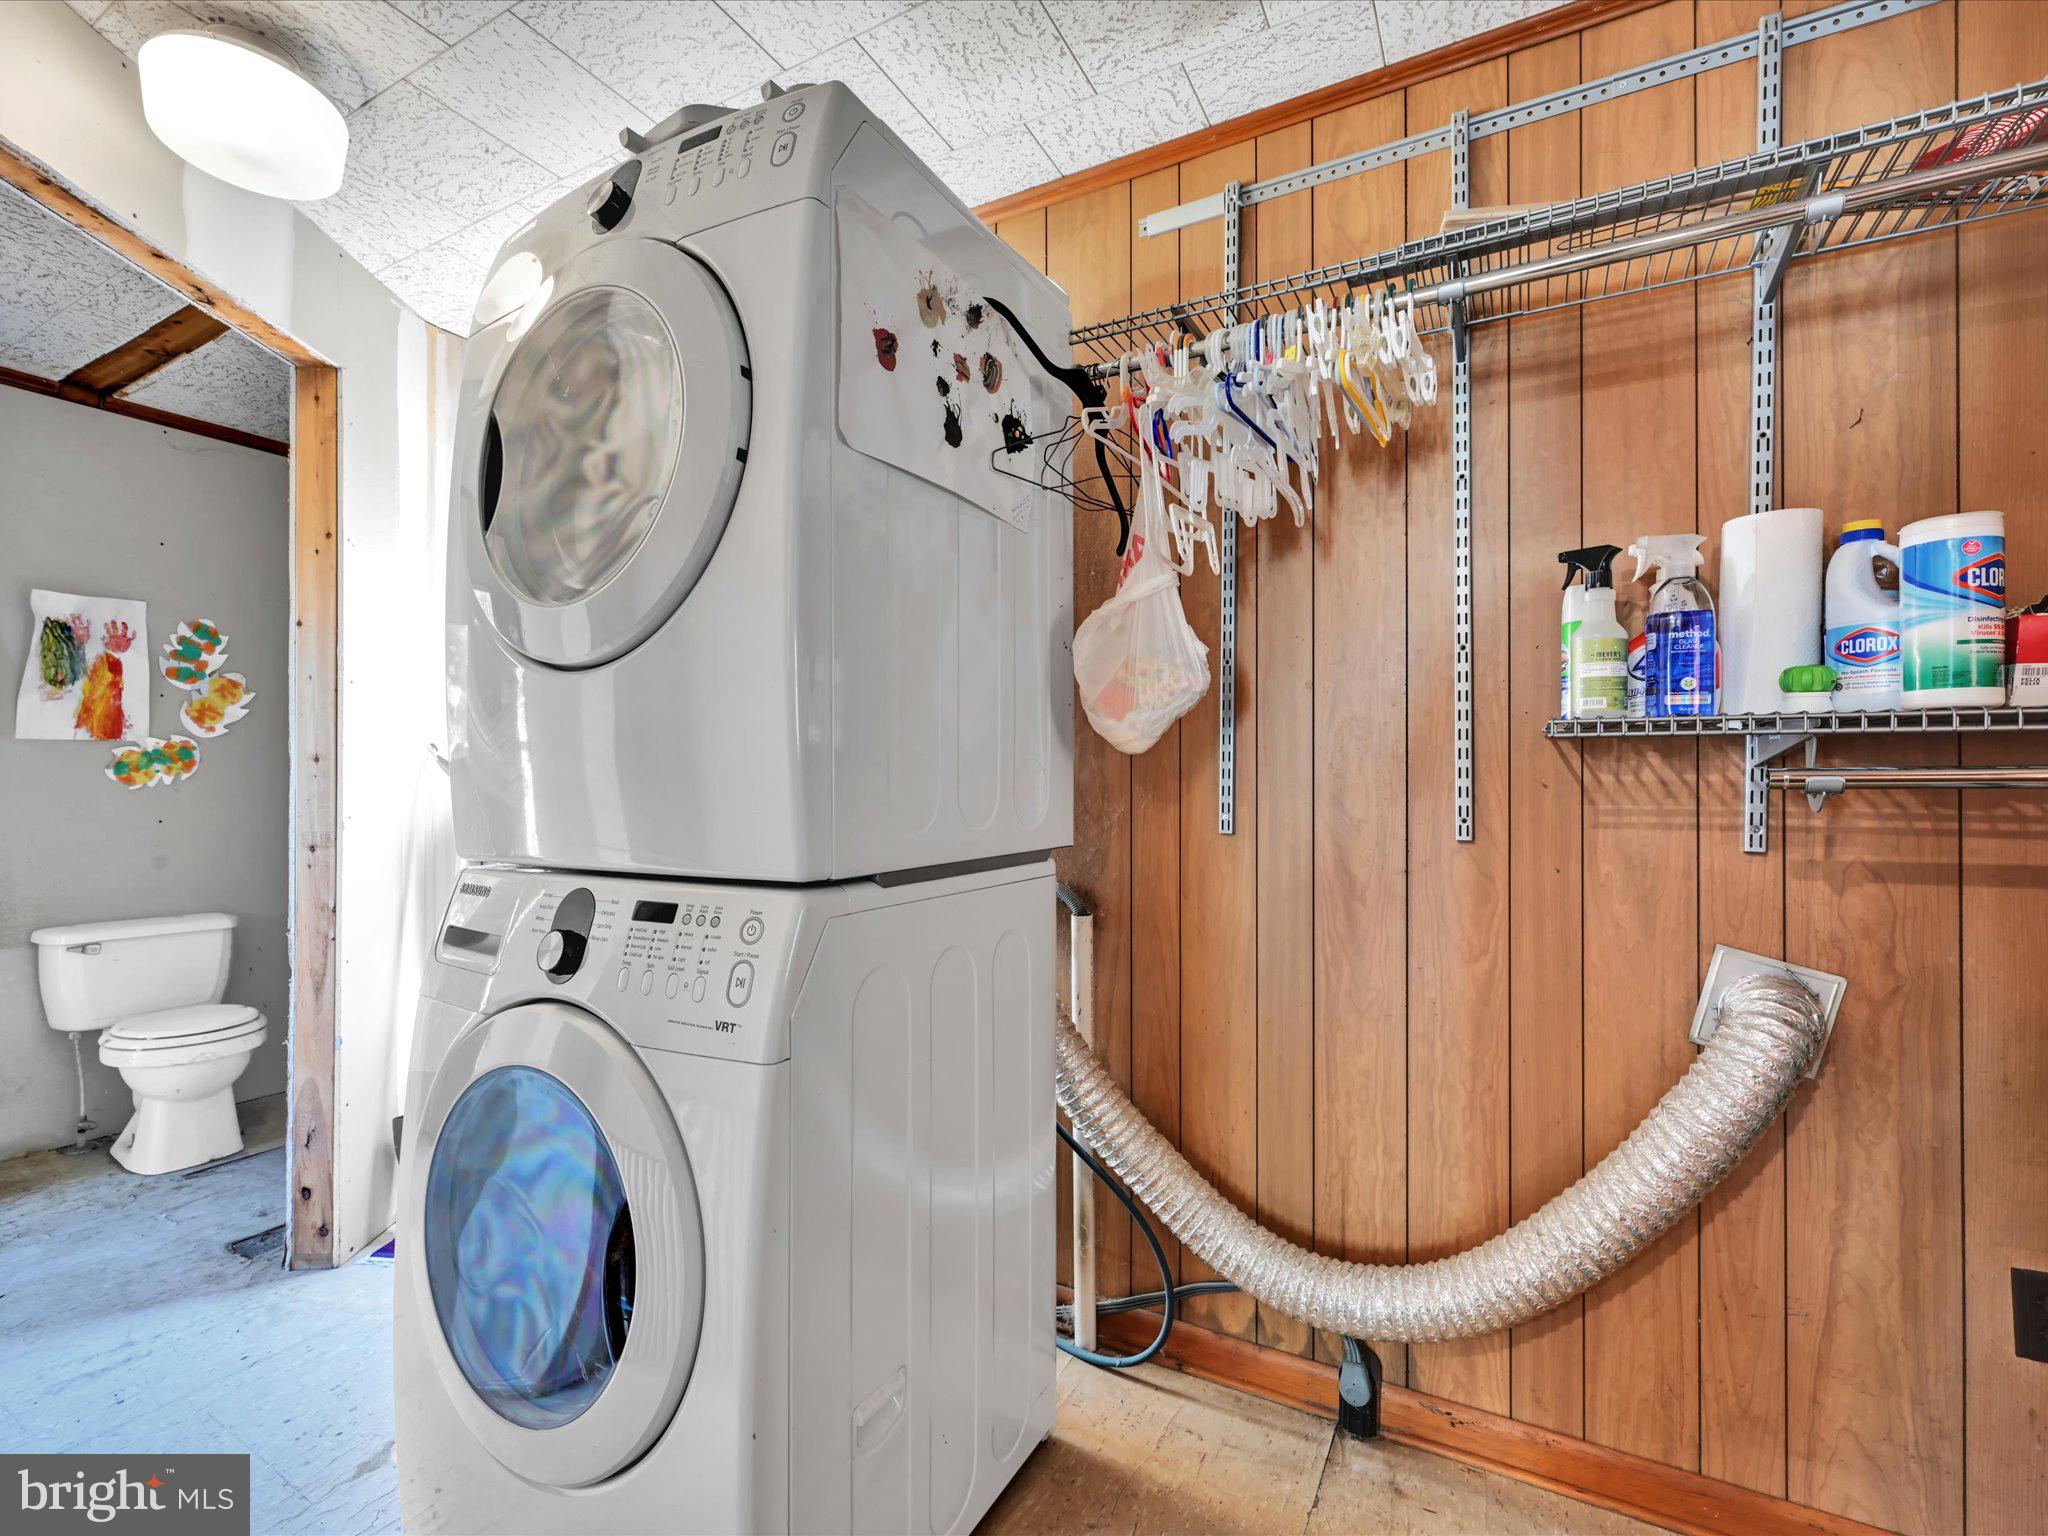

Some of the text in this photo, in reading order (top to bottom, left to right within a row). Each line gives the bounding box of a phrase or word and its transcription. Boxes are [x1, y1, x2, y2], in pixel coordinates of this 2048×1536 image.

[1669, 629, 1710, 639] method
[1841, 635, 1899, 655] CLOROX
[460, 883, 492, 898] SAMSUNG
[715, 1019, 737, 1034] VRT
